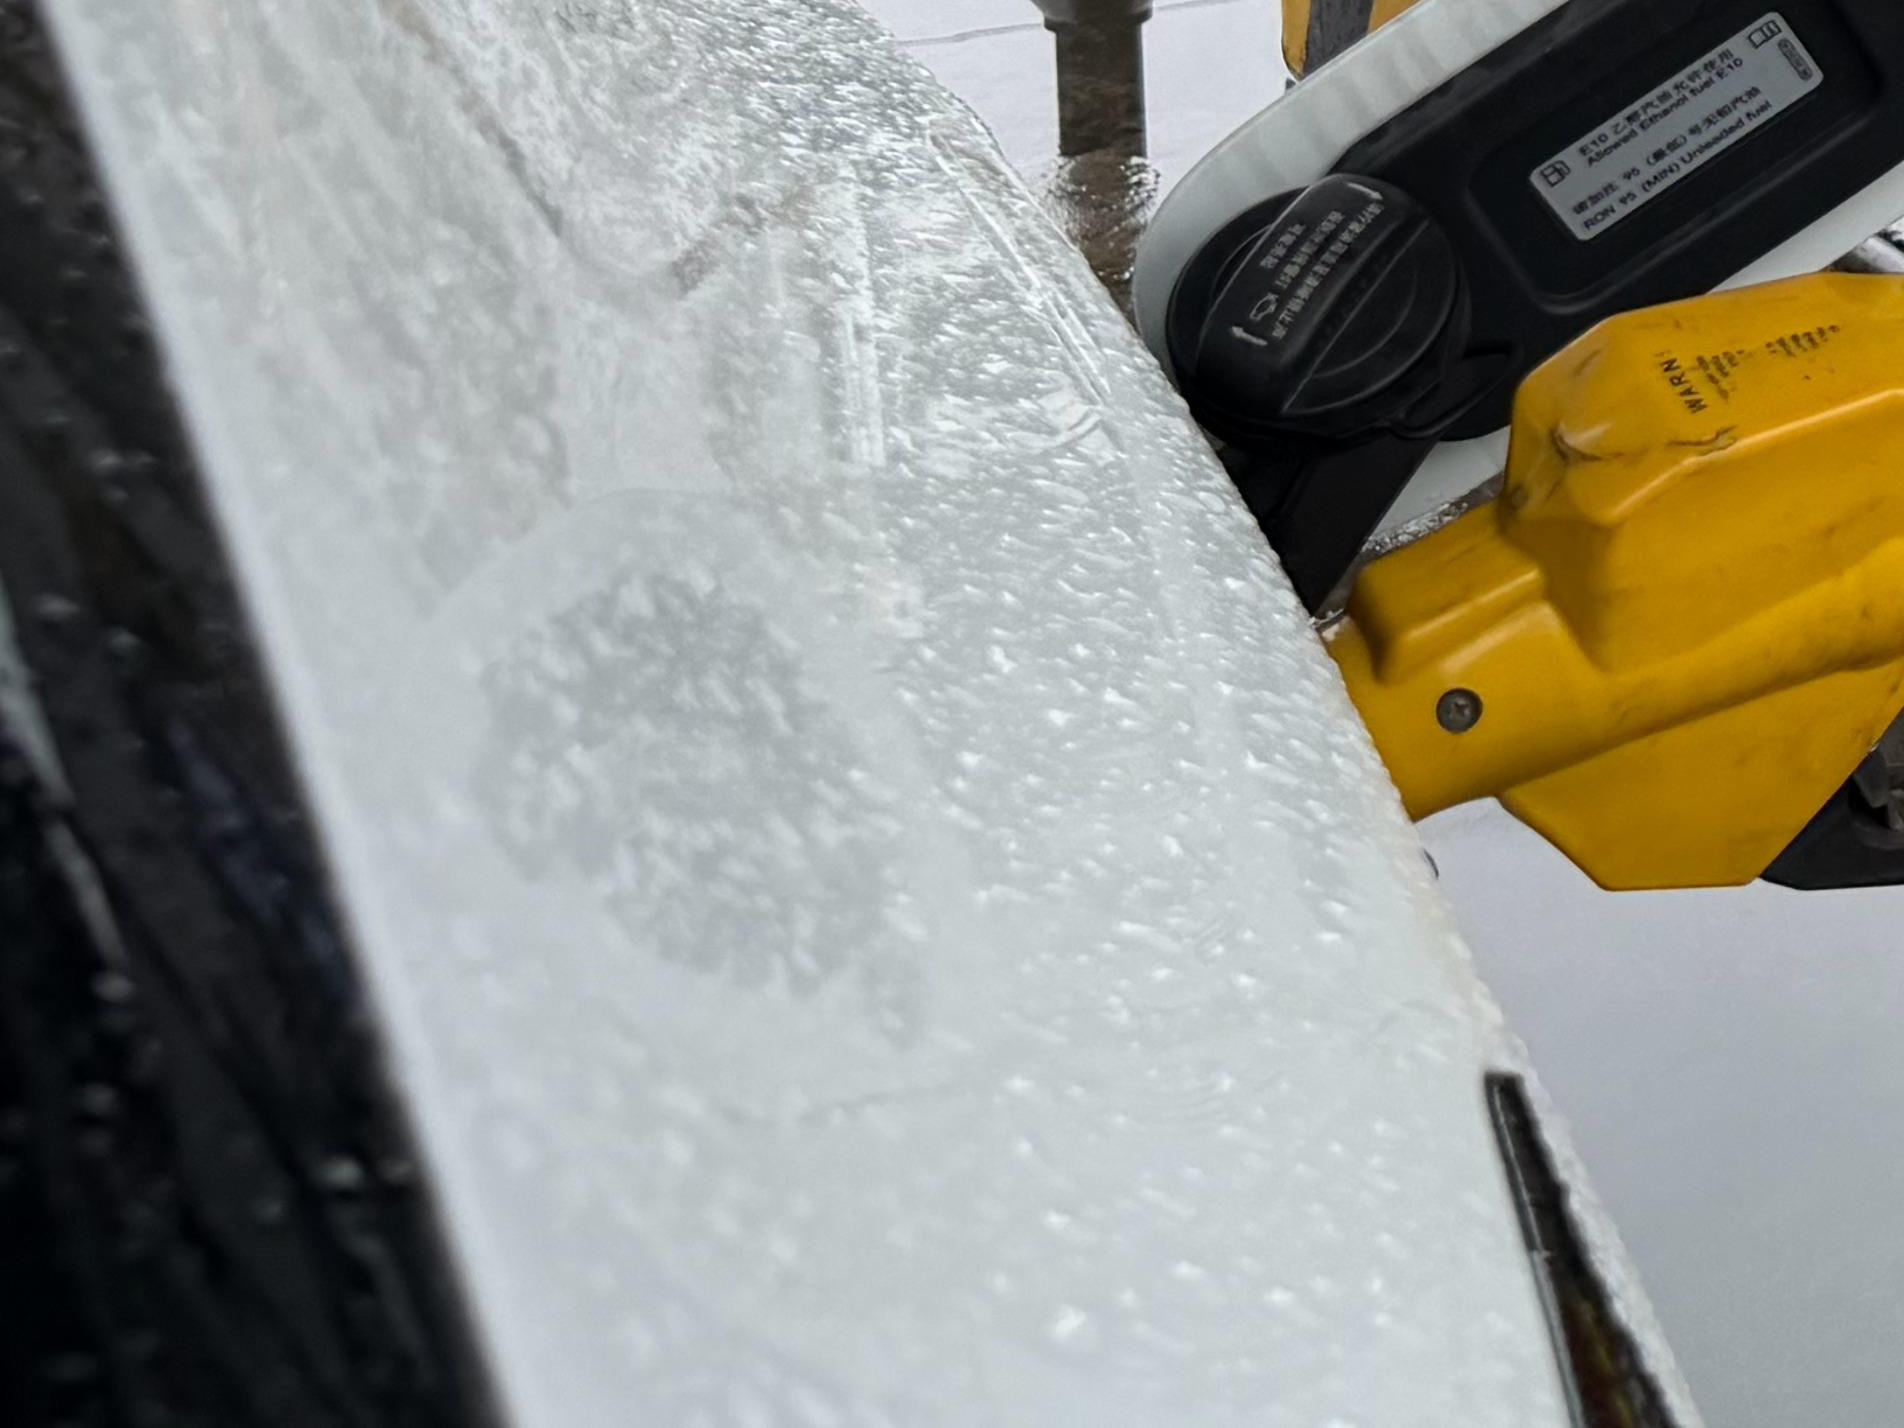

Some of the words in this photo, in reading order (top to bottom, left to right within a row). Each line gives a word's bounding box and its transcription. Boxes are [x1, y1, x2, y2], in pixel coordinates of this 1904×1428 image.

[1584, 207, 1616, 229] RON
[1642, 164, 1680, 192] (MIN)
[1682, 118, 1745, 164] Unleaded
[1746, 101, 1772, 120] fuel
[1588, 129, 1638, 166] Allowed
[1640, 94, 1689, 130] Ethanol
[1690, 76, 1714, 97] fuel
[1717, 58, 1743, 79] E10
[1658, 352, 1708, 414] WARN
